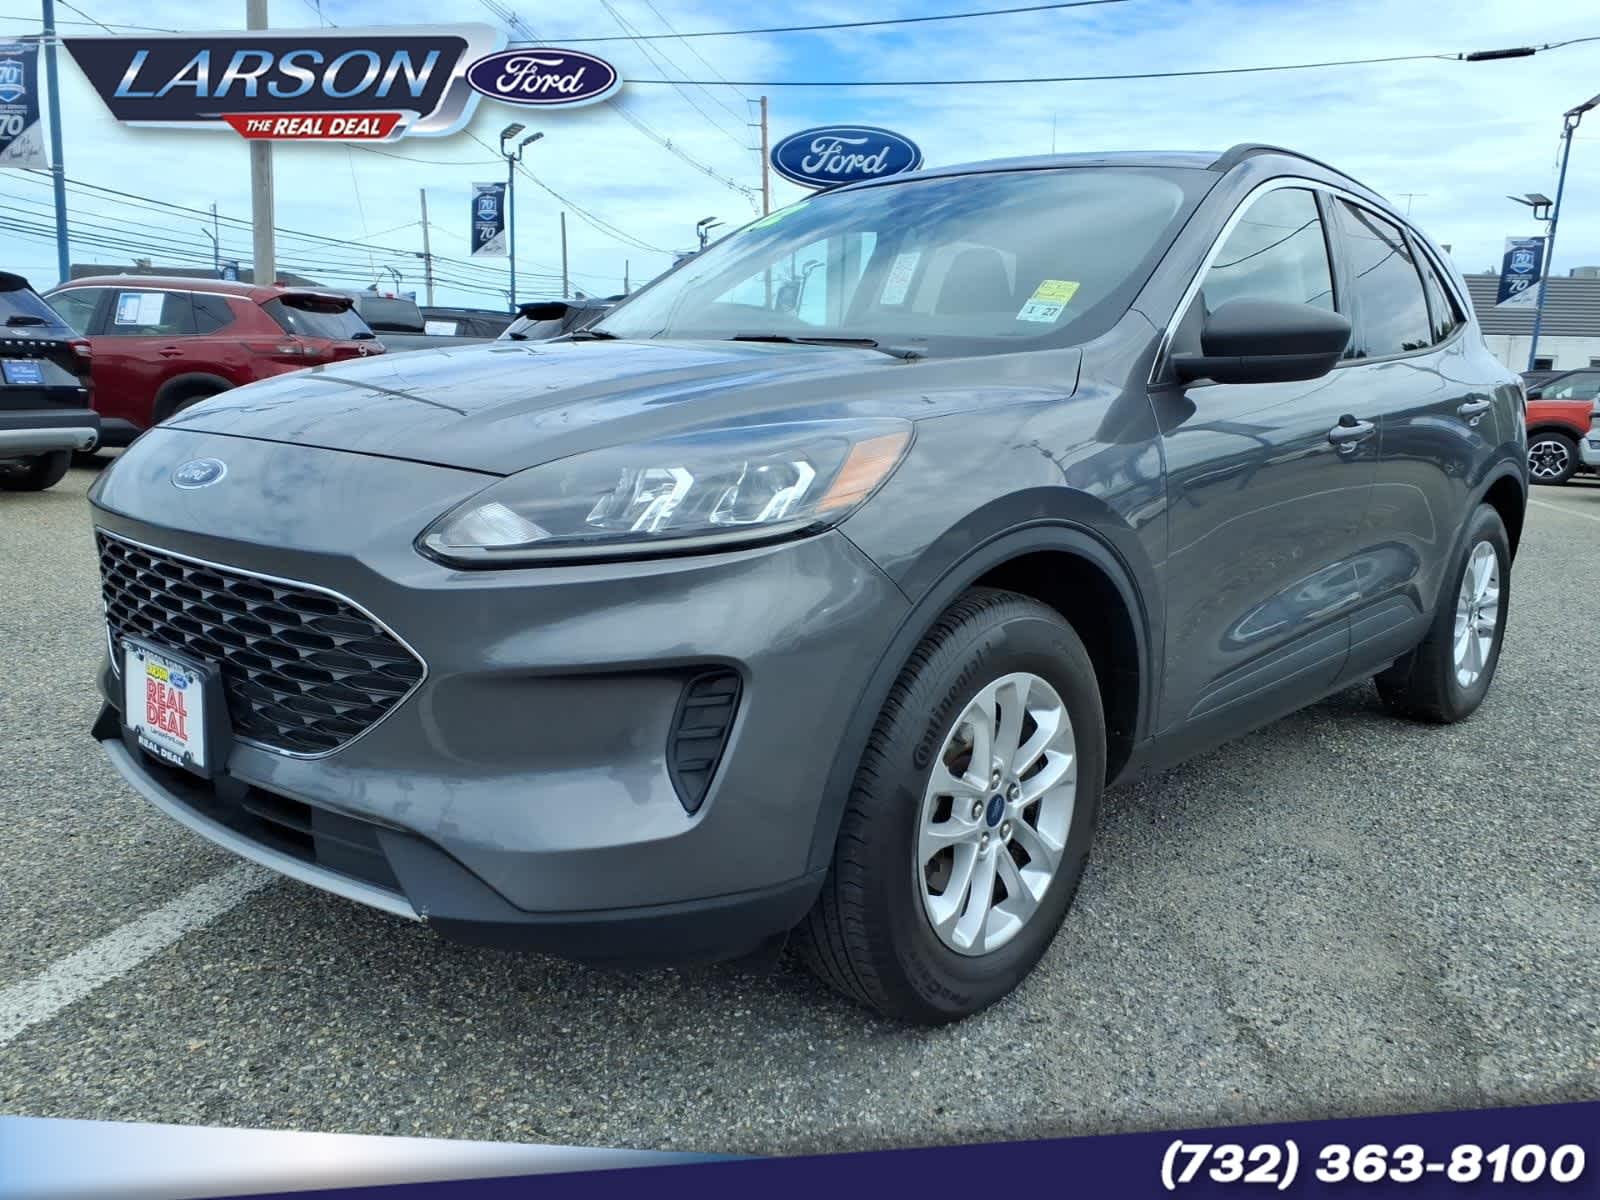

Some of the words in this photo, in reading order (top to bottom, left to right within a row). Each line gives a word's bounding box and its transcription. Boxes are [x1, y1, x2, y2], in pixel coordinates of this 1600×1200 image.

[801, 136, 890, 174] Ford
[480, 226, 496, 240] 70
[146, 677, 188, 717] REAL
[146, 701, 188, 741] DEAL
[138, 735, 160, 753] REAL
[160, 748, 184, 766] DEAL
